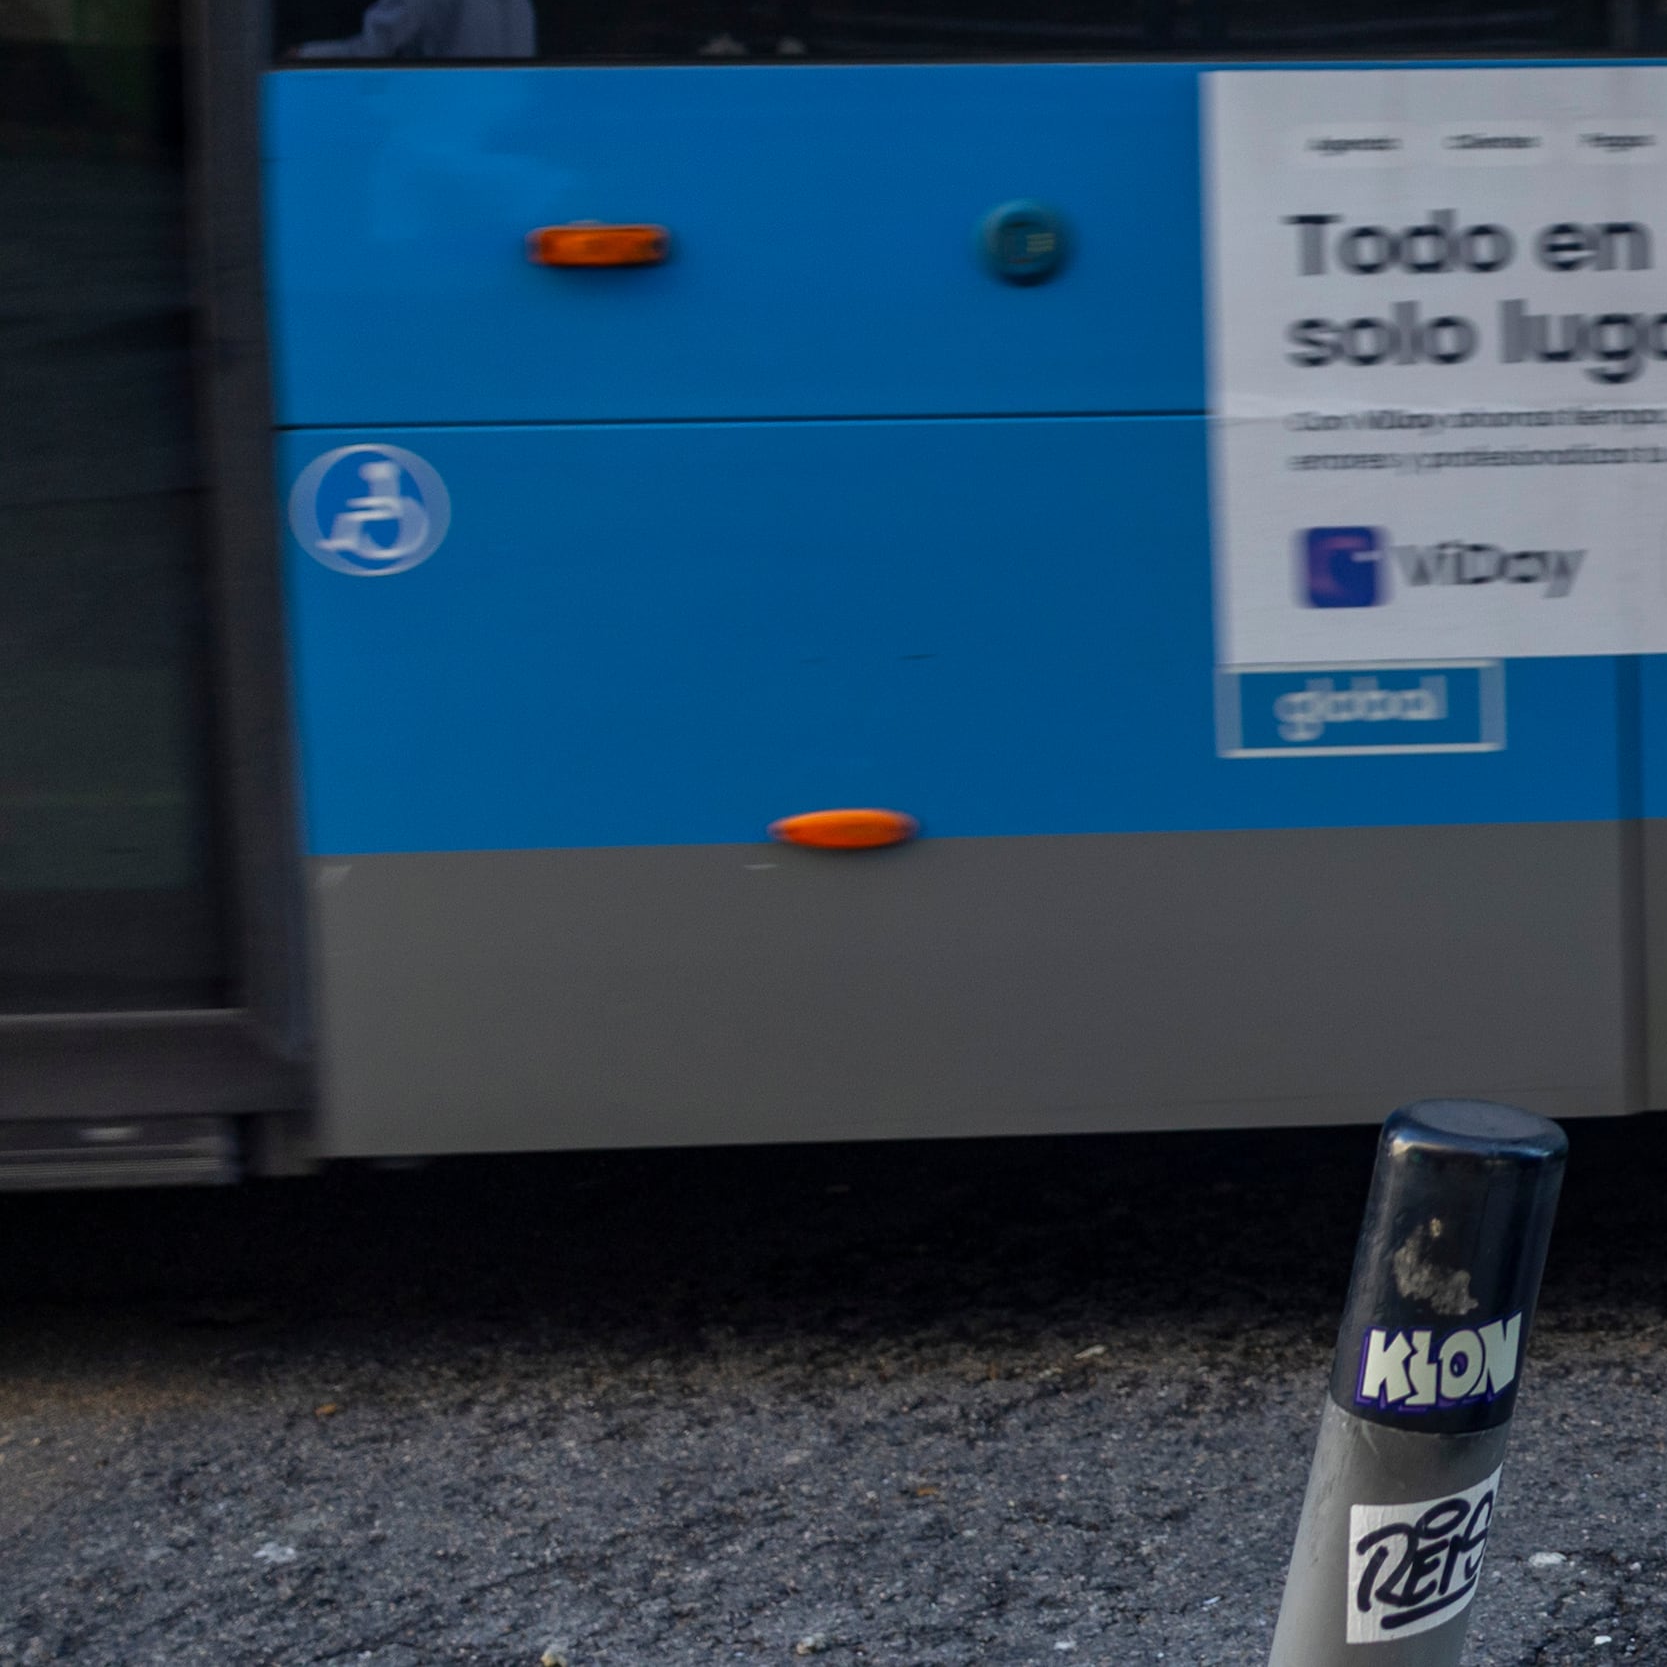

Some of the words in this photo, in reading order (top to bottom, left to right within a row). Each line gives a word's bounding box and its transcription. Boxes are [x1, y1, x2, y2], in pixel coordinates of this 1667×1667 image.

[1280, 207, 1515, 277] Todo
[1534, 220, 1654, 273] en
[1284, 299, 1479, 368] solo
[1273, 673, 1448, 743] global
[1355, 1311, 1523, 1412] KLON
